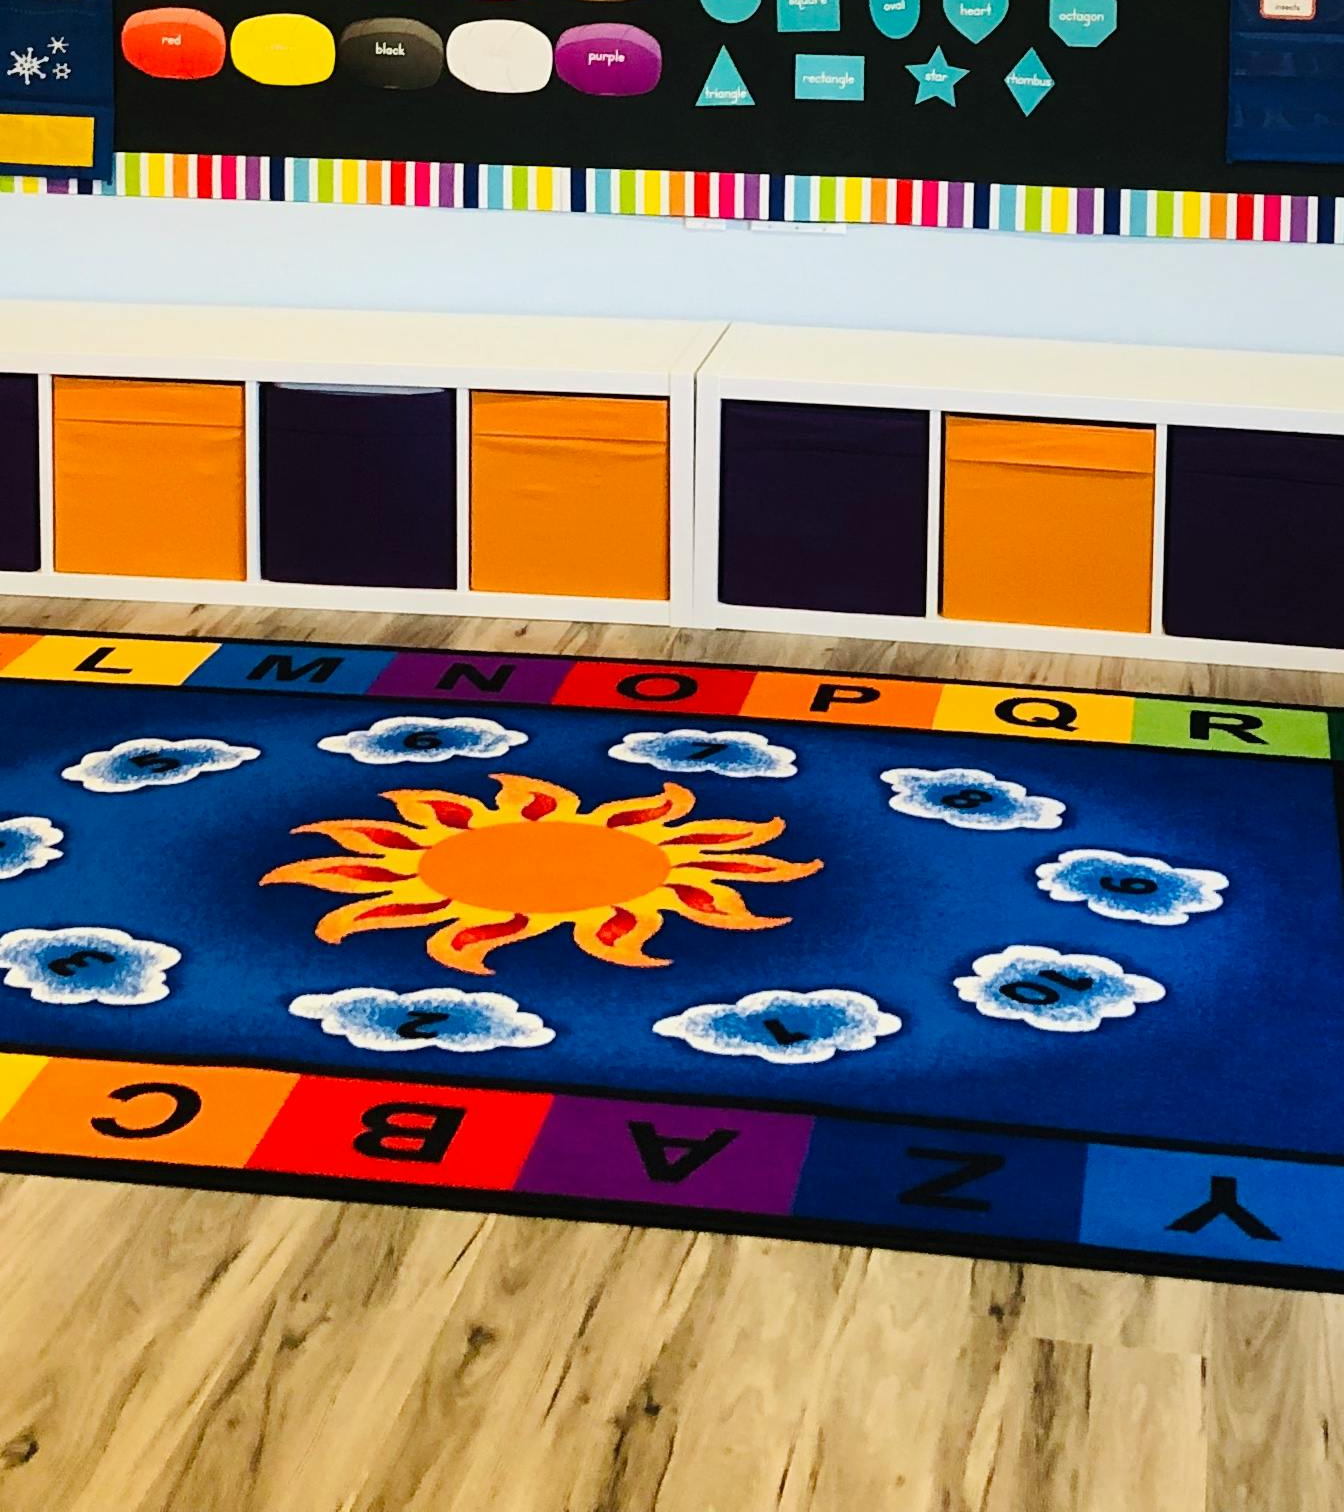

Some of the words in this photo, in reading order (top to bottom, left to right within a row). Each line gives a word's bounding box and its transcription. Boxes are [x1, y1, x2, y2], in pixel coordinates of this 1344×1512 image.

[959, 2, 993, 16] heart
[1058, 7, 1105, 27] octagon
[161, 34, 182, 46] red
[375, 41, 406, 56] black
[588, 49, 626, 66] purple
[802, 71, 855, 90] rectangle
[924, 68, 948, 82] star
[1004, 73, 1053, 88] rhombus
[705, 86, 748, 104] triangle
[74, 646, 134, 674] L
[246, 654, 346, 684] M
[434, 662, 518, 693] N
[616, 672, 699, 703] O
[809, 683, 882, 713] P
[994, 696, 1078, 732] Q
[1189, 709, 1269, 746] R
[403, 730, 443, 751] 6
[689, 743, 729, 760] 7
[130, 752, 180, 774] 5
[940, 788, 994, 809] 8
[1099, 876, 1158, 896] 9
[48, 949, 116, 977] 3
[998, 968, 1094, 1007] 10
[395, 1010, 450, 1040] 2
[89, 1082, 203, 1140] C
[352, 1101, 467, 1165] B
[626, 1120, 741, 1184] A
[897, 1145, 1007, 1213] Z
[1164, 1176, 1283, 1242] Y
